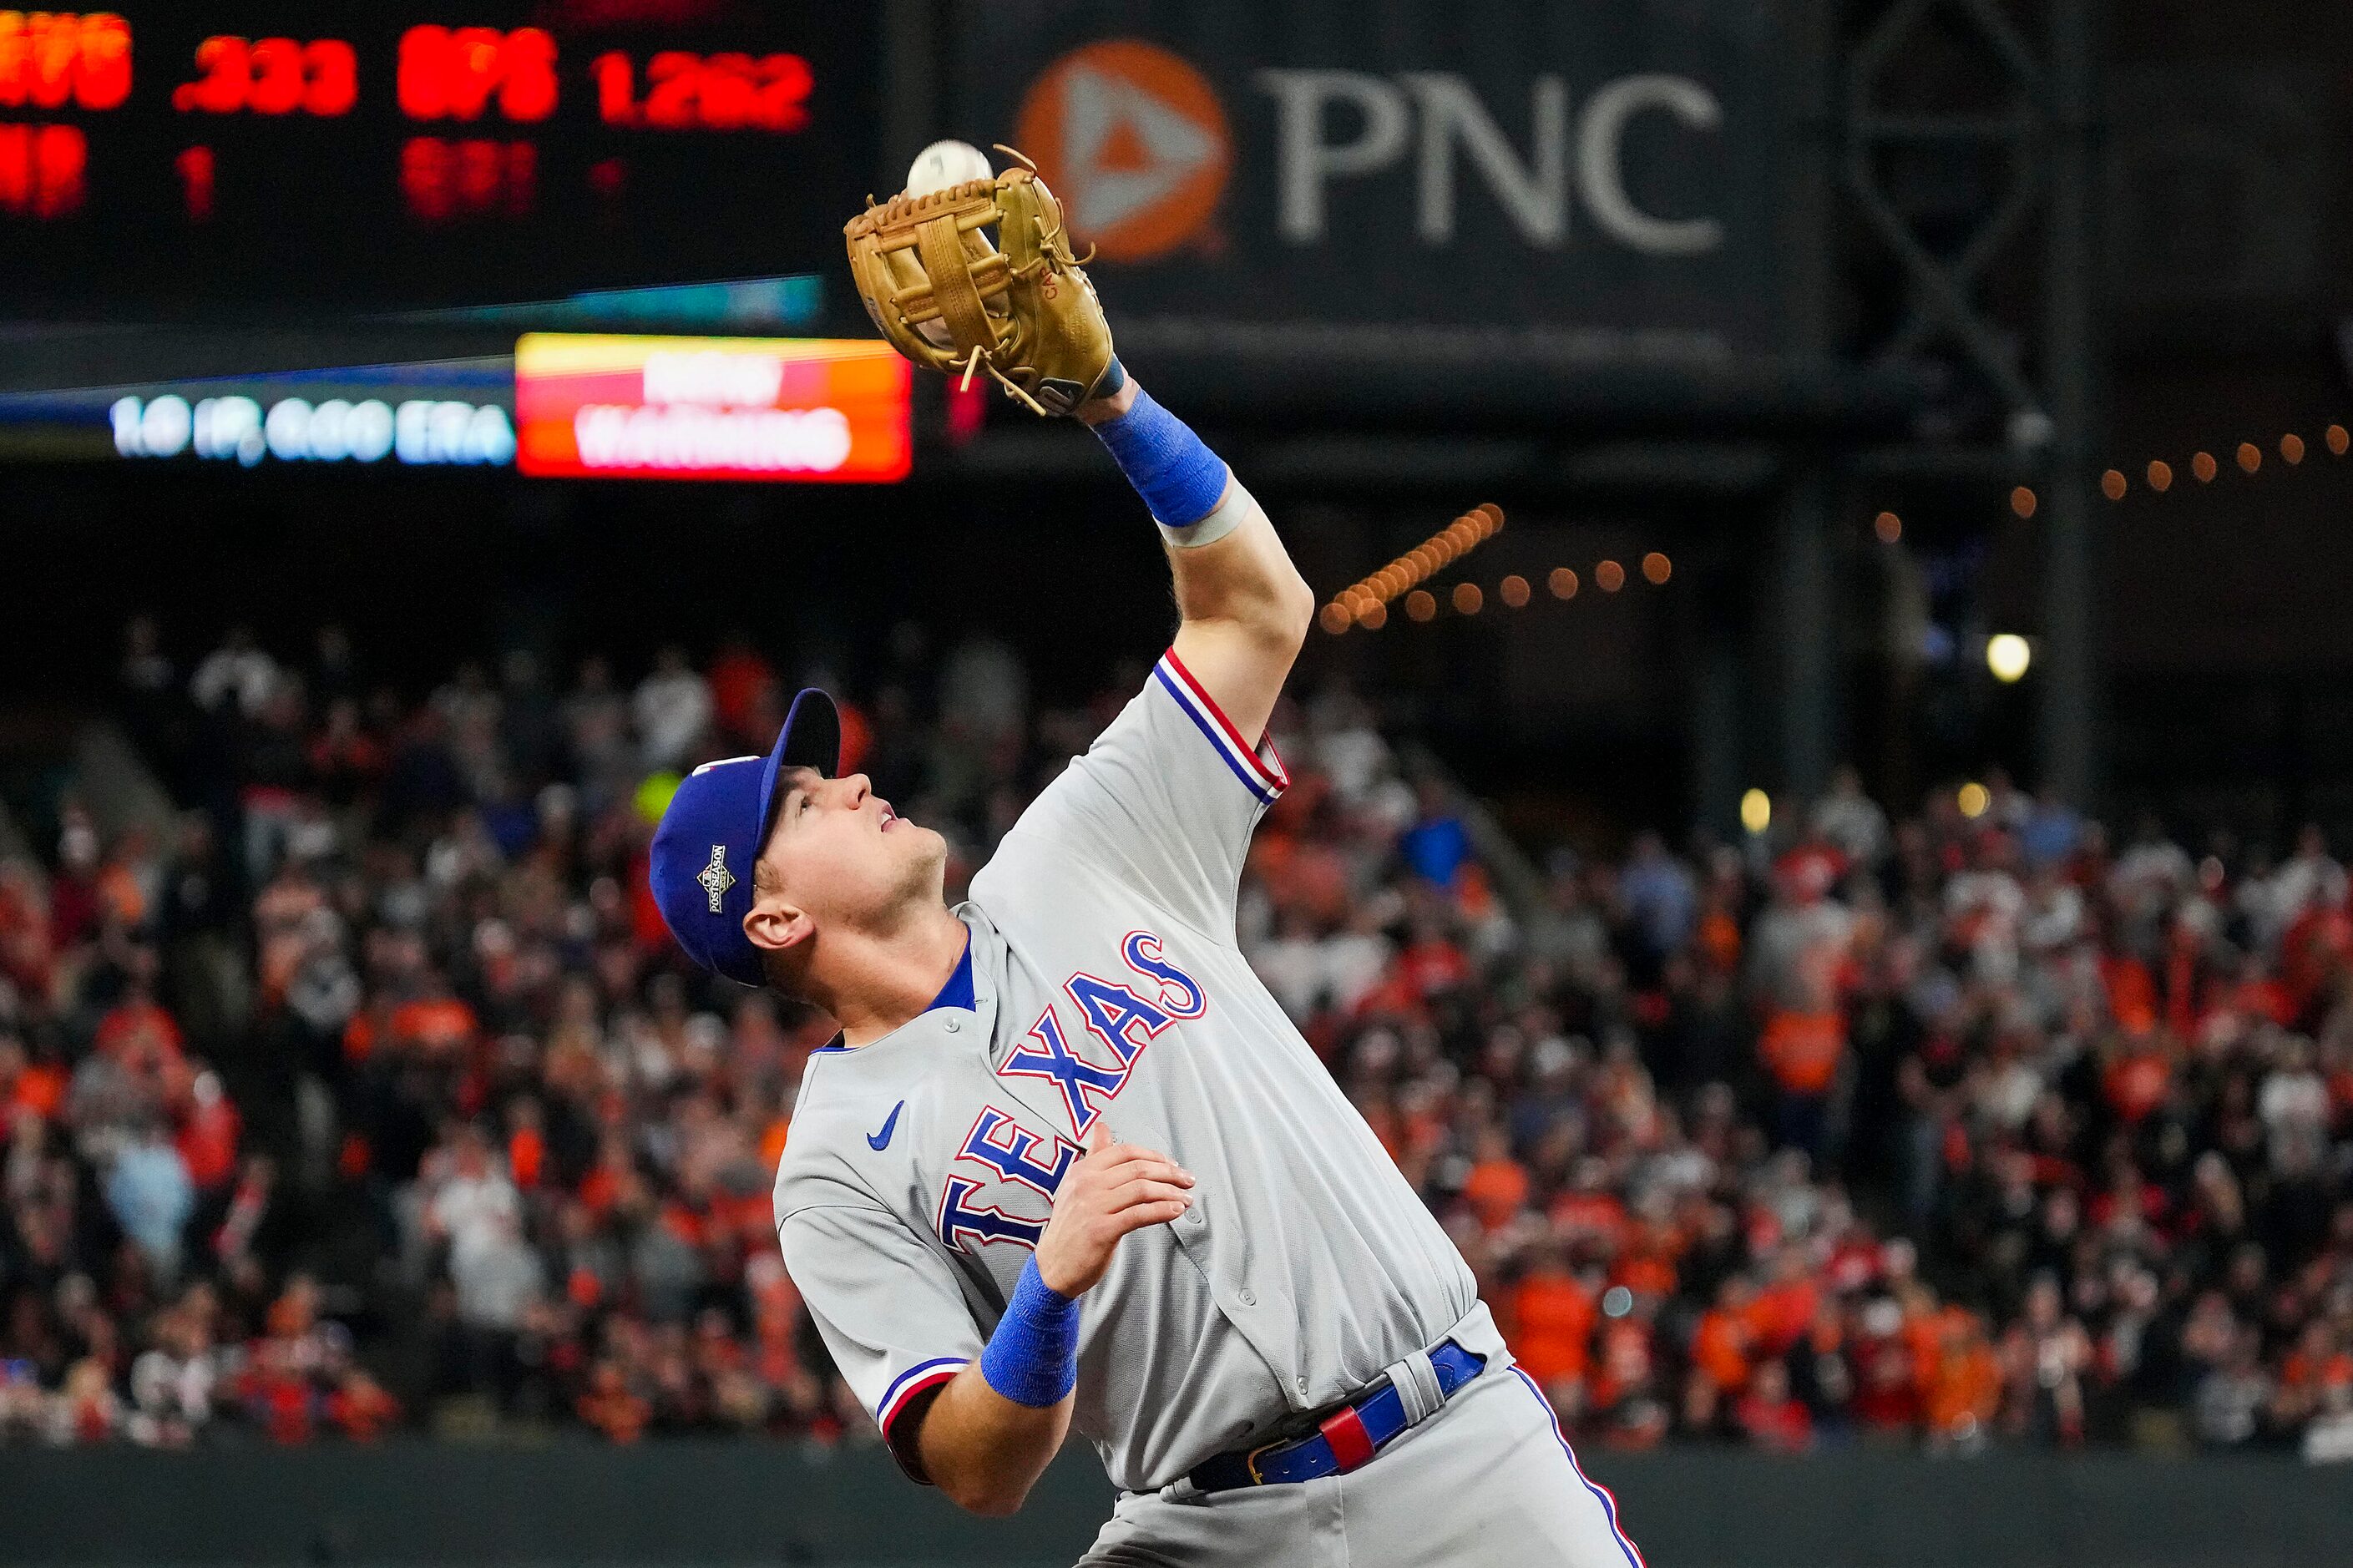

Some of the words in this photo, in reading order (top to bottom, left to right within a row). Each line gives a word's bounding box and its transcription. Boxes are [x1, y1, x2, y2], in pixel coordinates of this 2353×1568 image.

[1256, 67, 1723, 253] PNC
[711, 845, 724, 913] POSTSEASON
[936, 929, 1207, 1256] TEXAS
